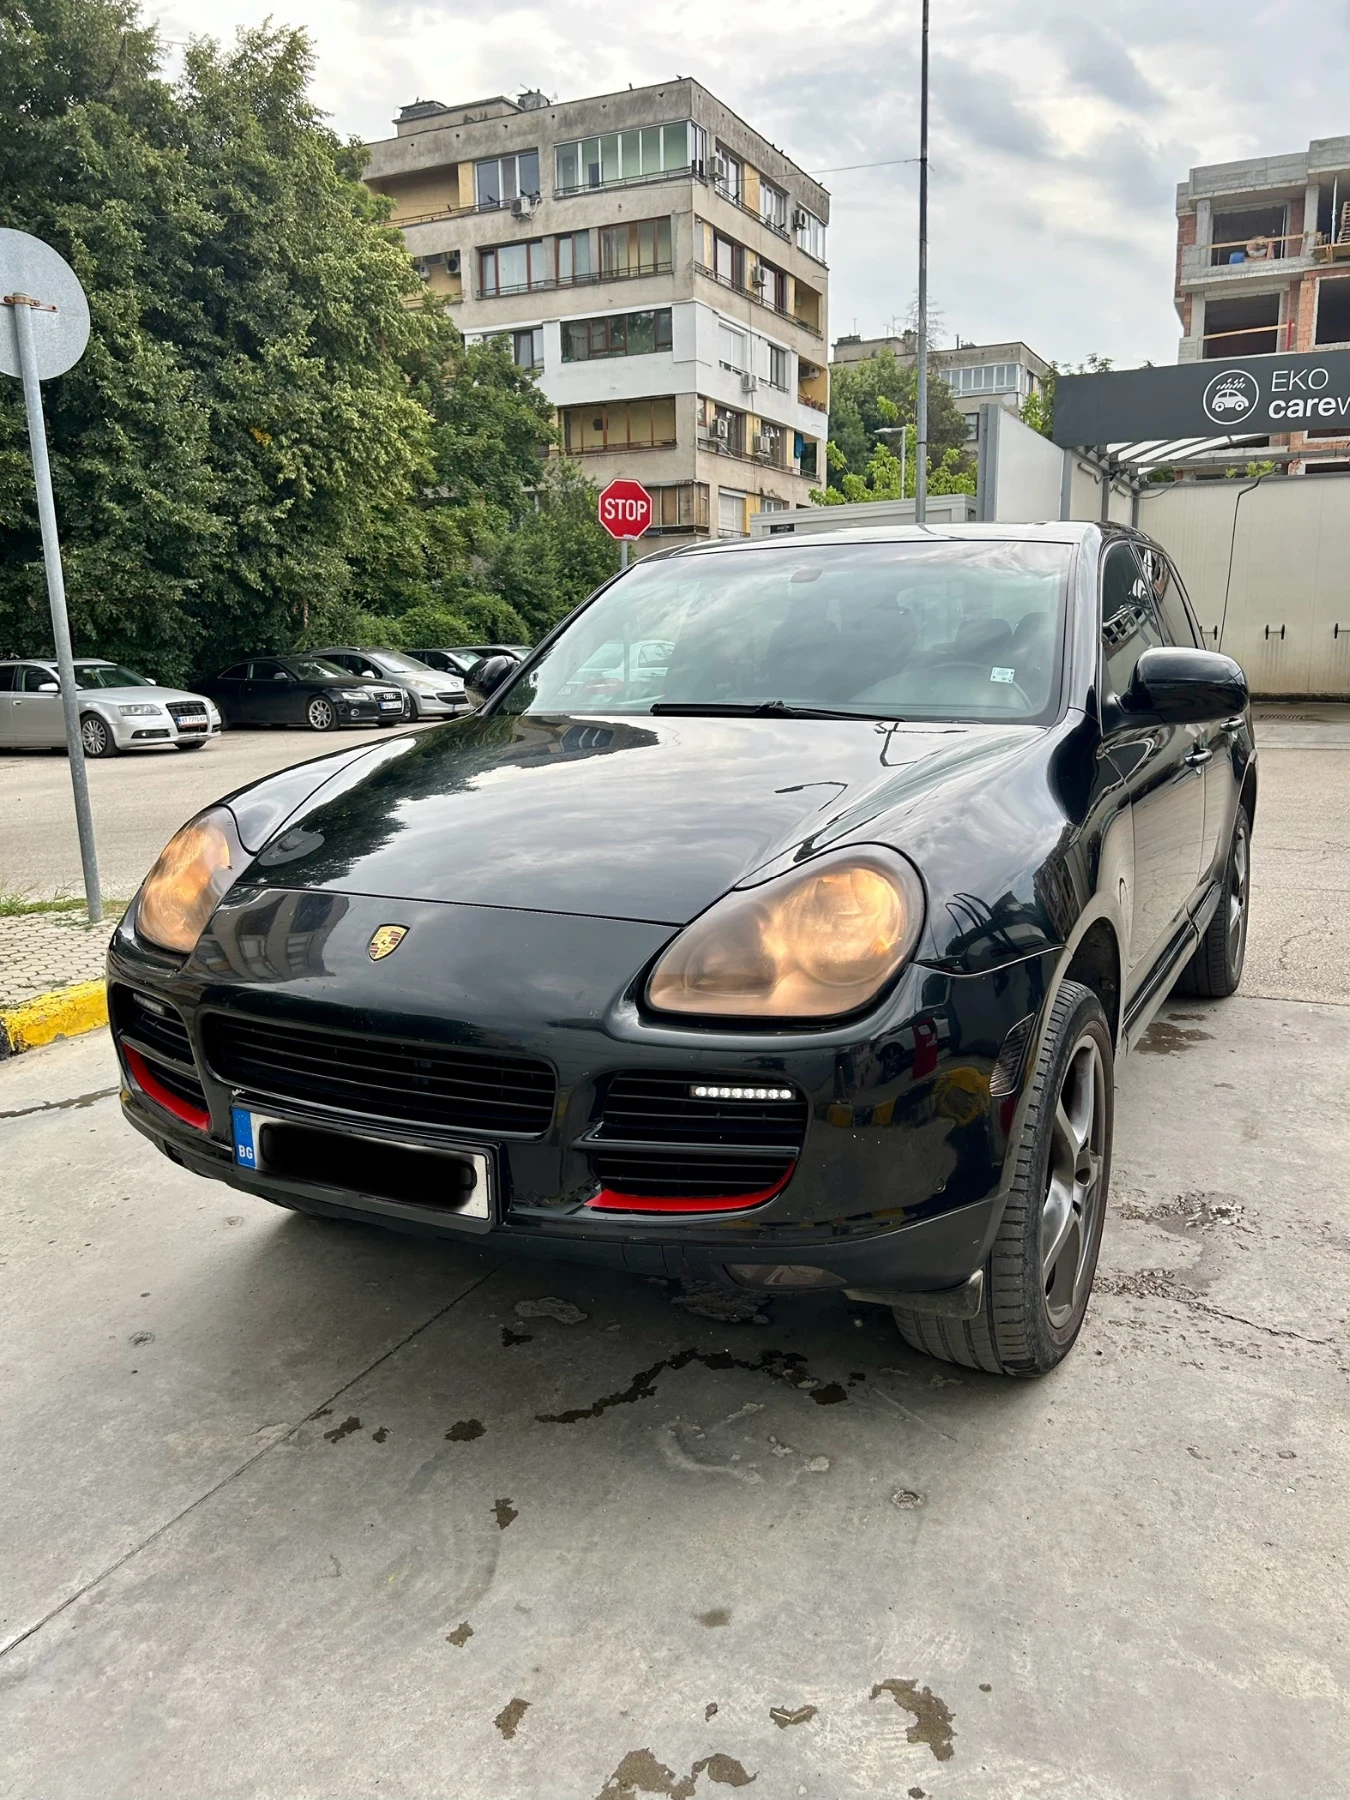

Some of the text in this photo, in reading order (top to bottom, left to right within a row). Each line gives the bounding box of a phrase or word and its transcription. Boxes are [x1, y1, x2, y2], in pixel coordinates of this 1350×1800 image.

[1271, 367, 1329, 392] EKO
[604, 498, 648, 521] STOP
[238, 1144, 254, 1160] BG
